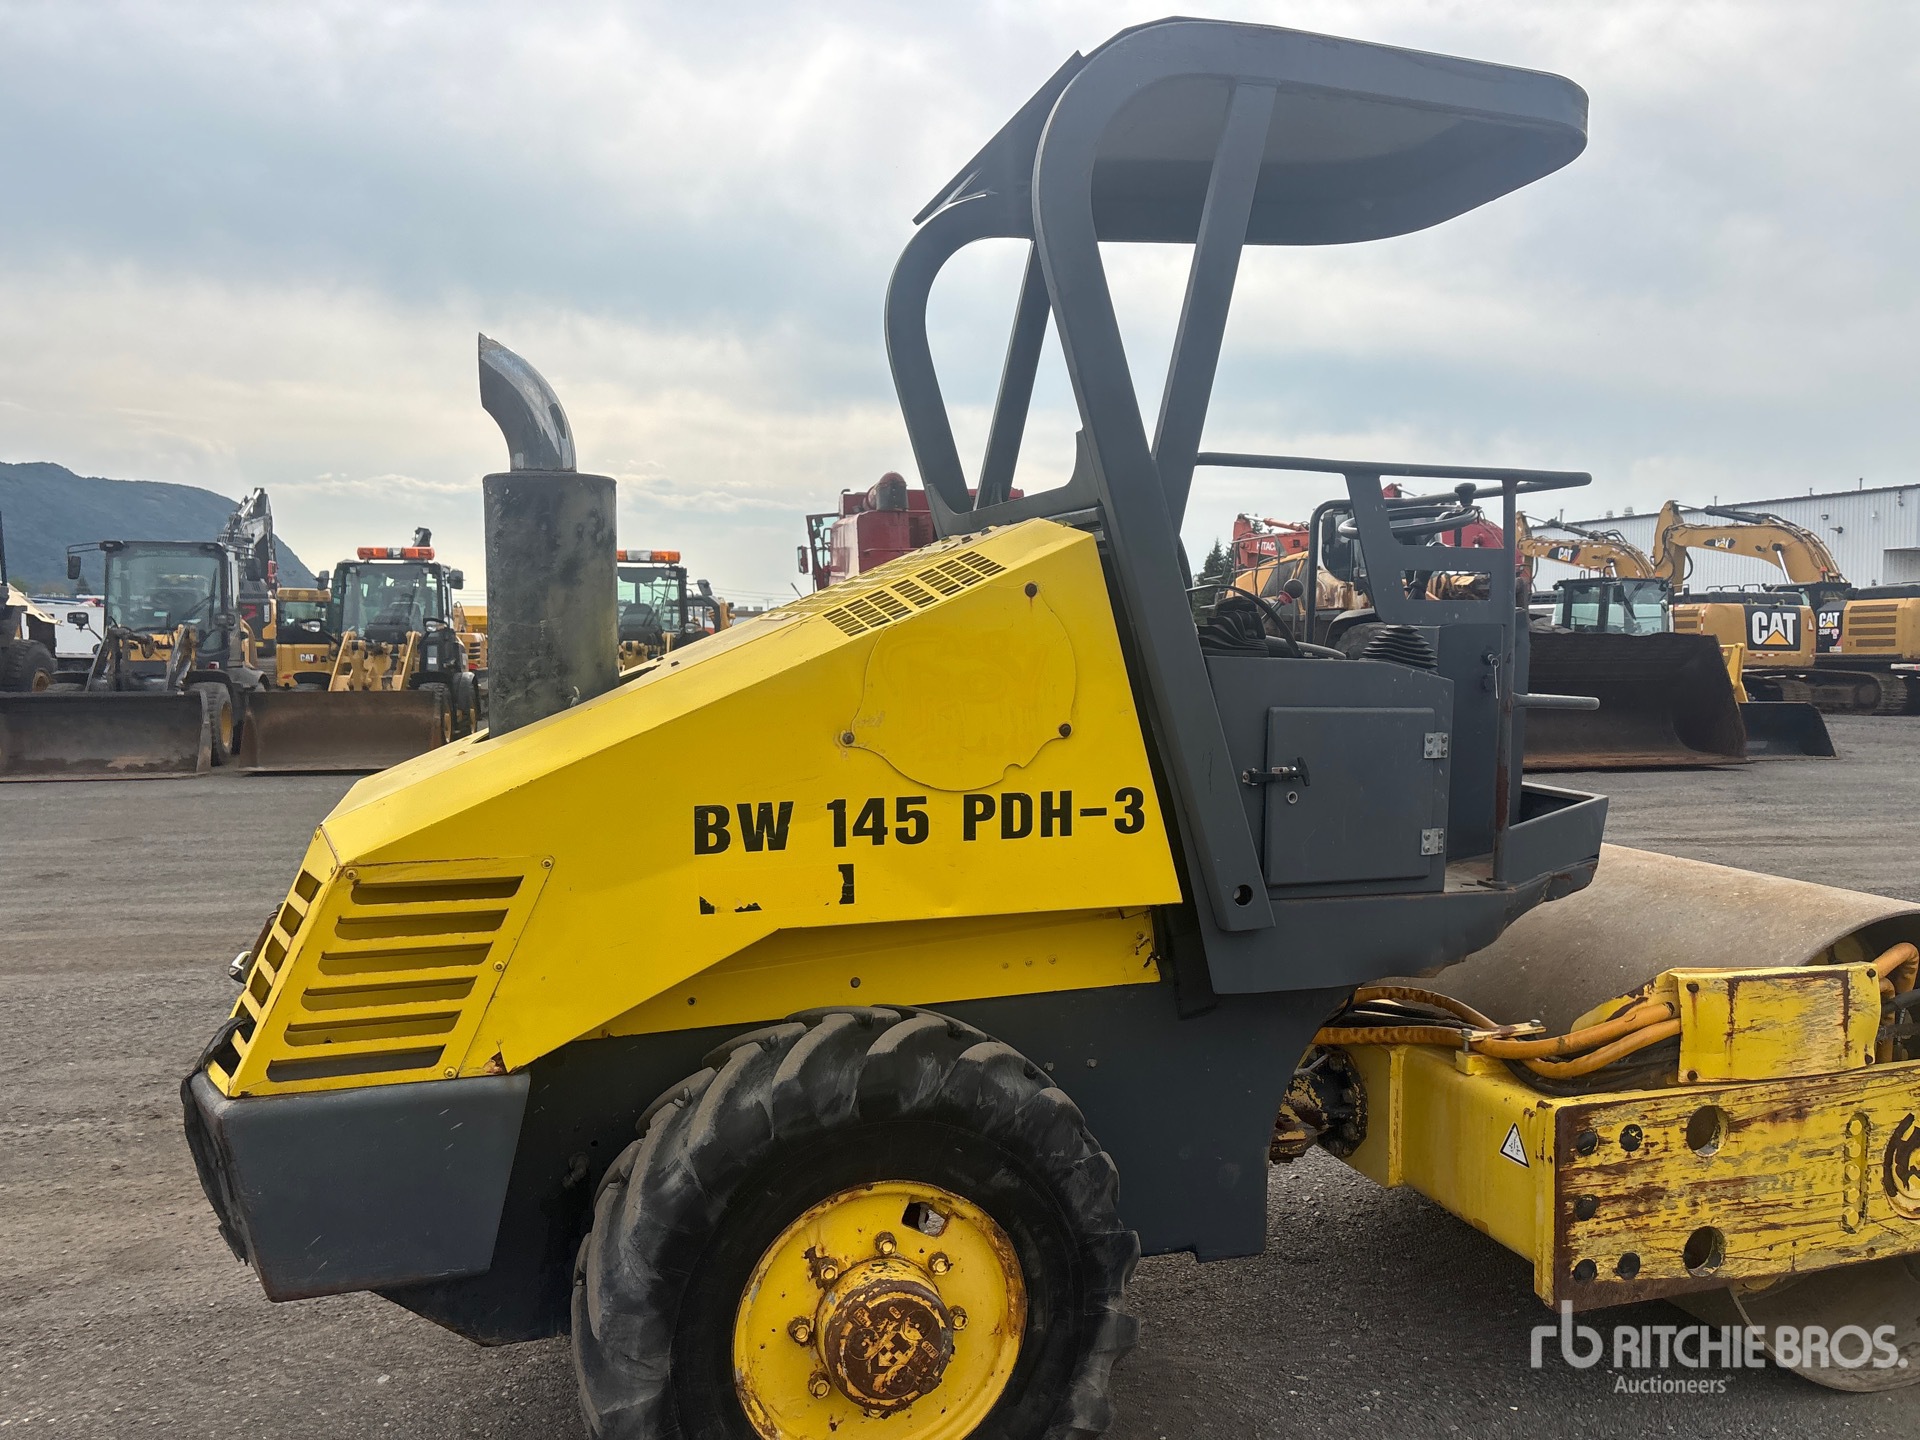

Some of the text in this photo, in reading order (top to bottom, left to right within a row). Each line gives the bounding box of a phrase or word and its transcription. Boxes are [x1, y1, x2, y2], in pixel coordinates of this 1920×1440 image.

[1256, 541, 1276, 551] HITAC
[1558, 547, 1573, 561] CAT
[1819, 612, 1840, 627] CAT
[1752, 611, 1796, 645] CAT
[300, 653, 315, 662] CAT
[694, 787, 1145, 855] BW 145 PDH-3
